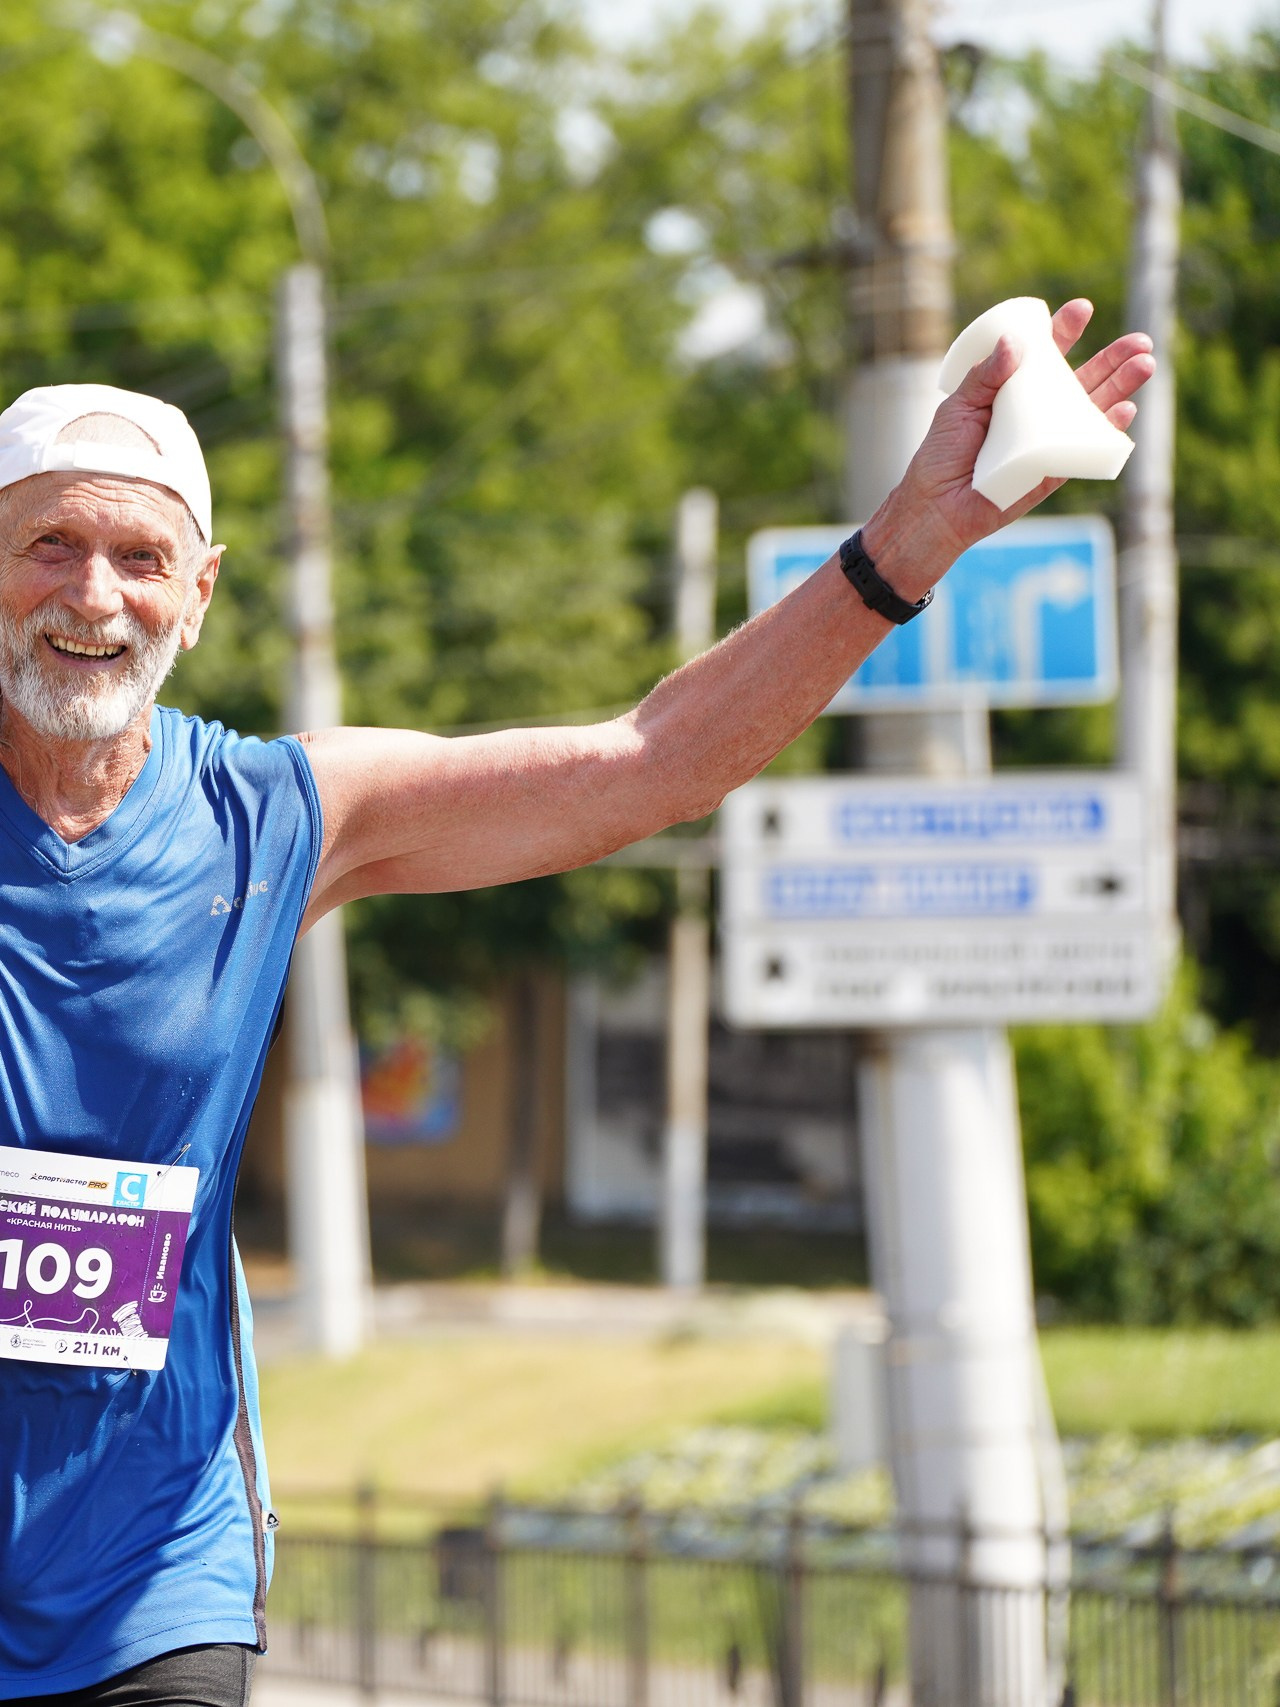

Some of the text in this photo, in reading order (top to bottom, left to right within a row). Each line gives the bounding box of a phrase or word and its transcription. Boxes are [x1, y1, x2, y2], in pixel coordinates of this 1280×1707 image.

[88, 1181, 108, 1189] PRO
[40, 1204, 145, 1228] ПОЛУМАРАФОН
[6, 1217, 81, 1232] «КРАСНАЯ НИТЬ»
[156, 1233, 172, 1280] Иваново
[72, 1341, 99, 1355] 21.1
